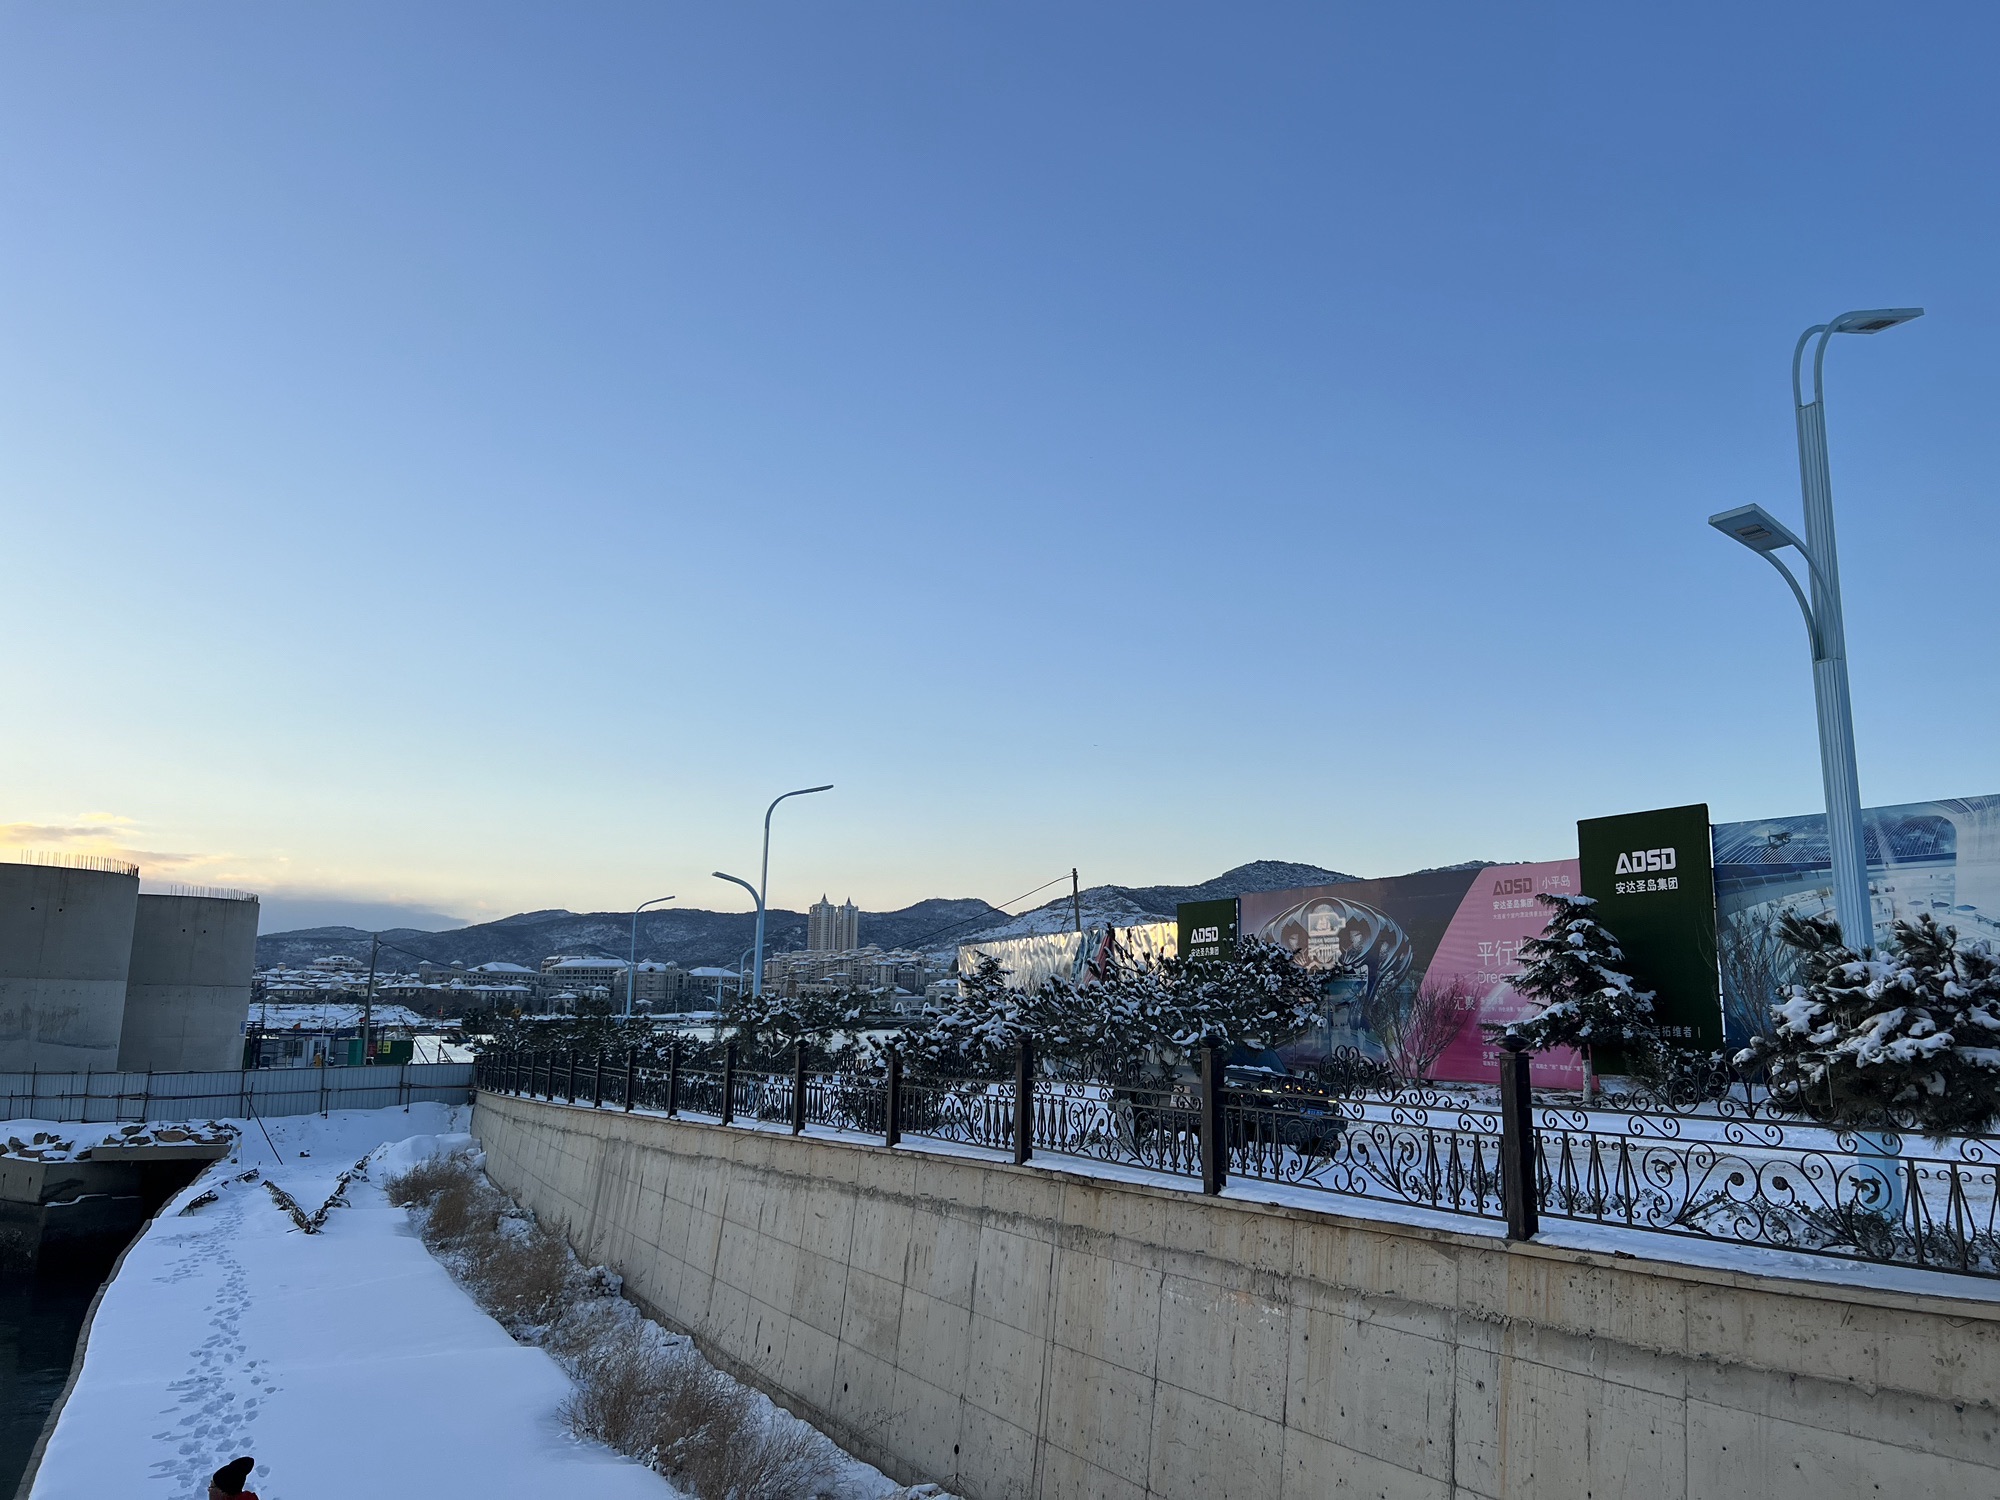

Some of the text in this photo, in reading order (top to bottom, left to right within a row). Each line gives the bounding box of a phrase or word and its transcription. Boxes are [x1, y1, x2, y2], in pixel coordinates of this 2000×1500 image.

[1615, 847, 1676, 875] ADSD
[1492, 877, 1533, 896] ADSD
[1541, 875, 1571, 889] 小平岛
[1615, 877, 1679, 894] 安达圣岛集团
[1492, 898, 1534, 910] 安达圣岛集团
[1190, 926, 1219, 944] ADSD
